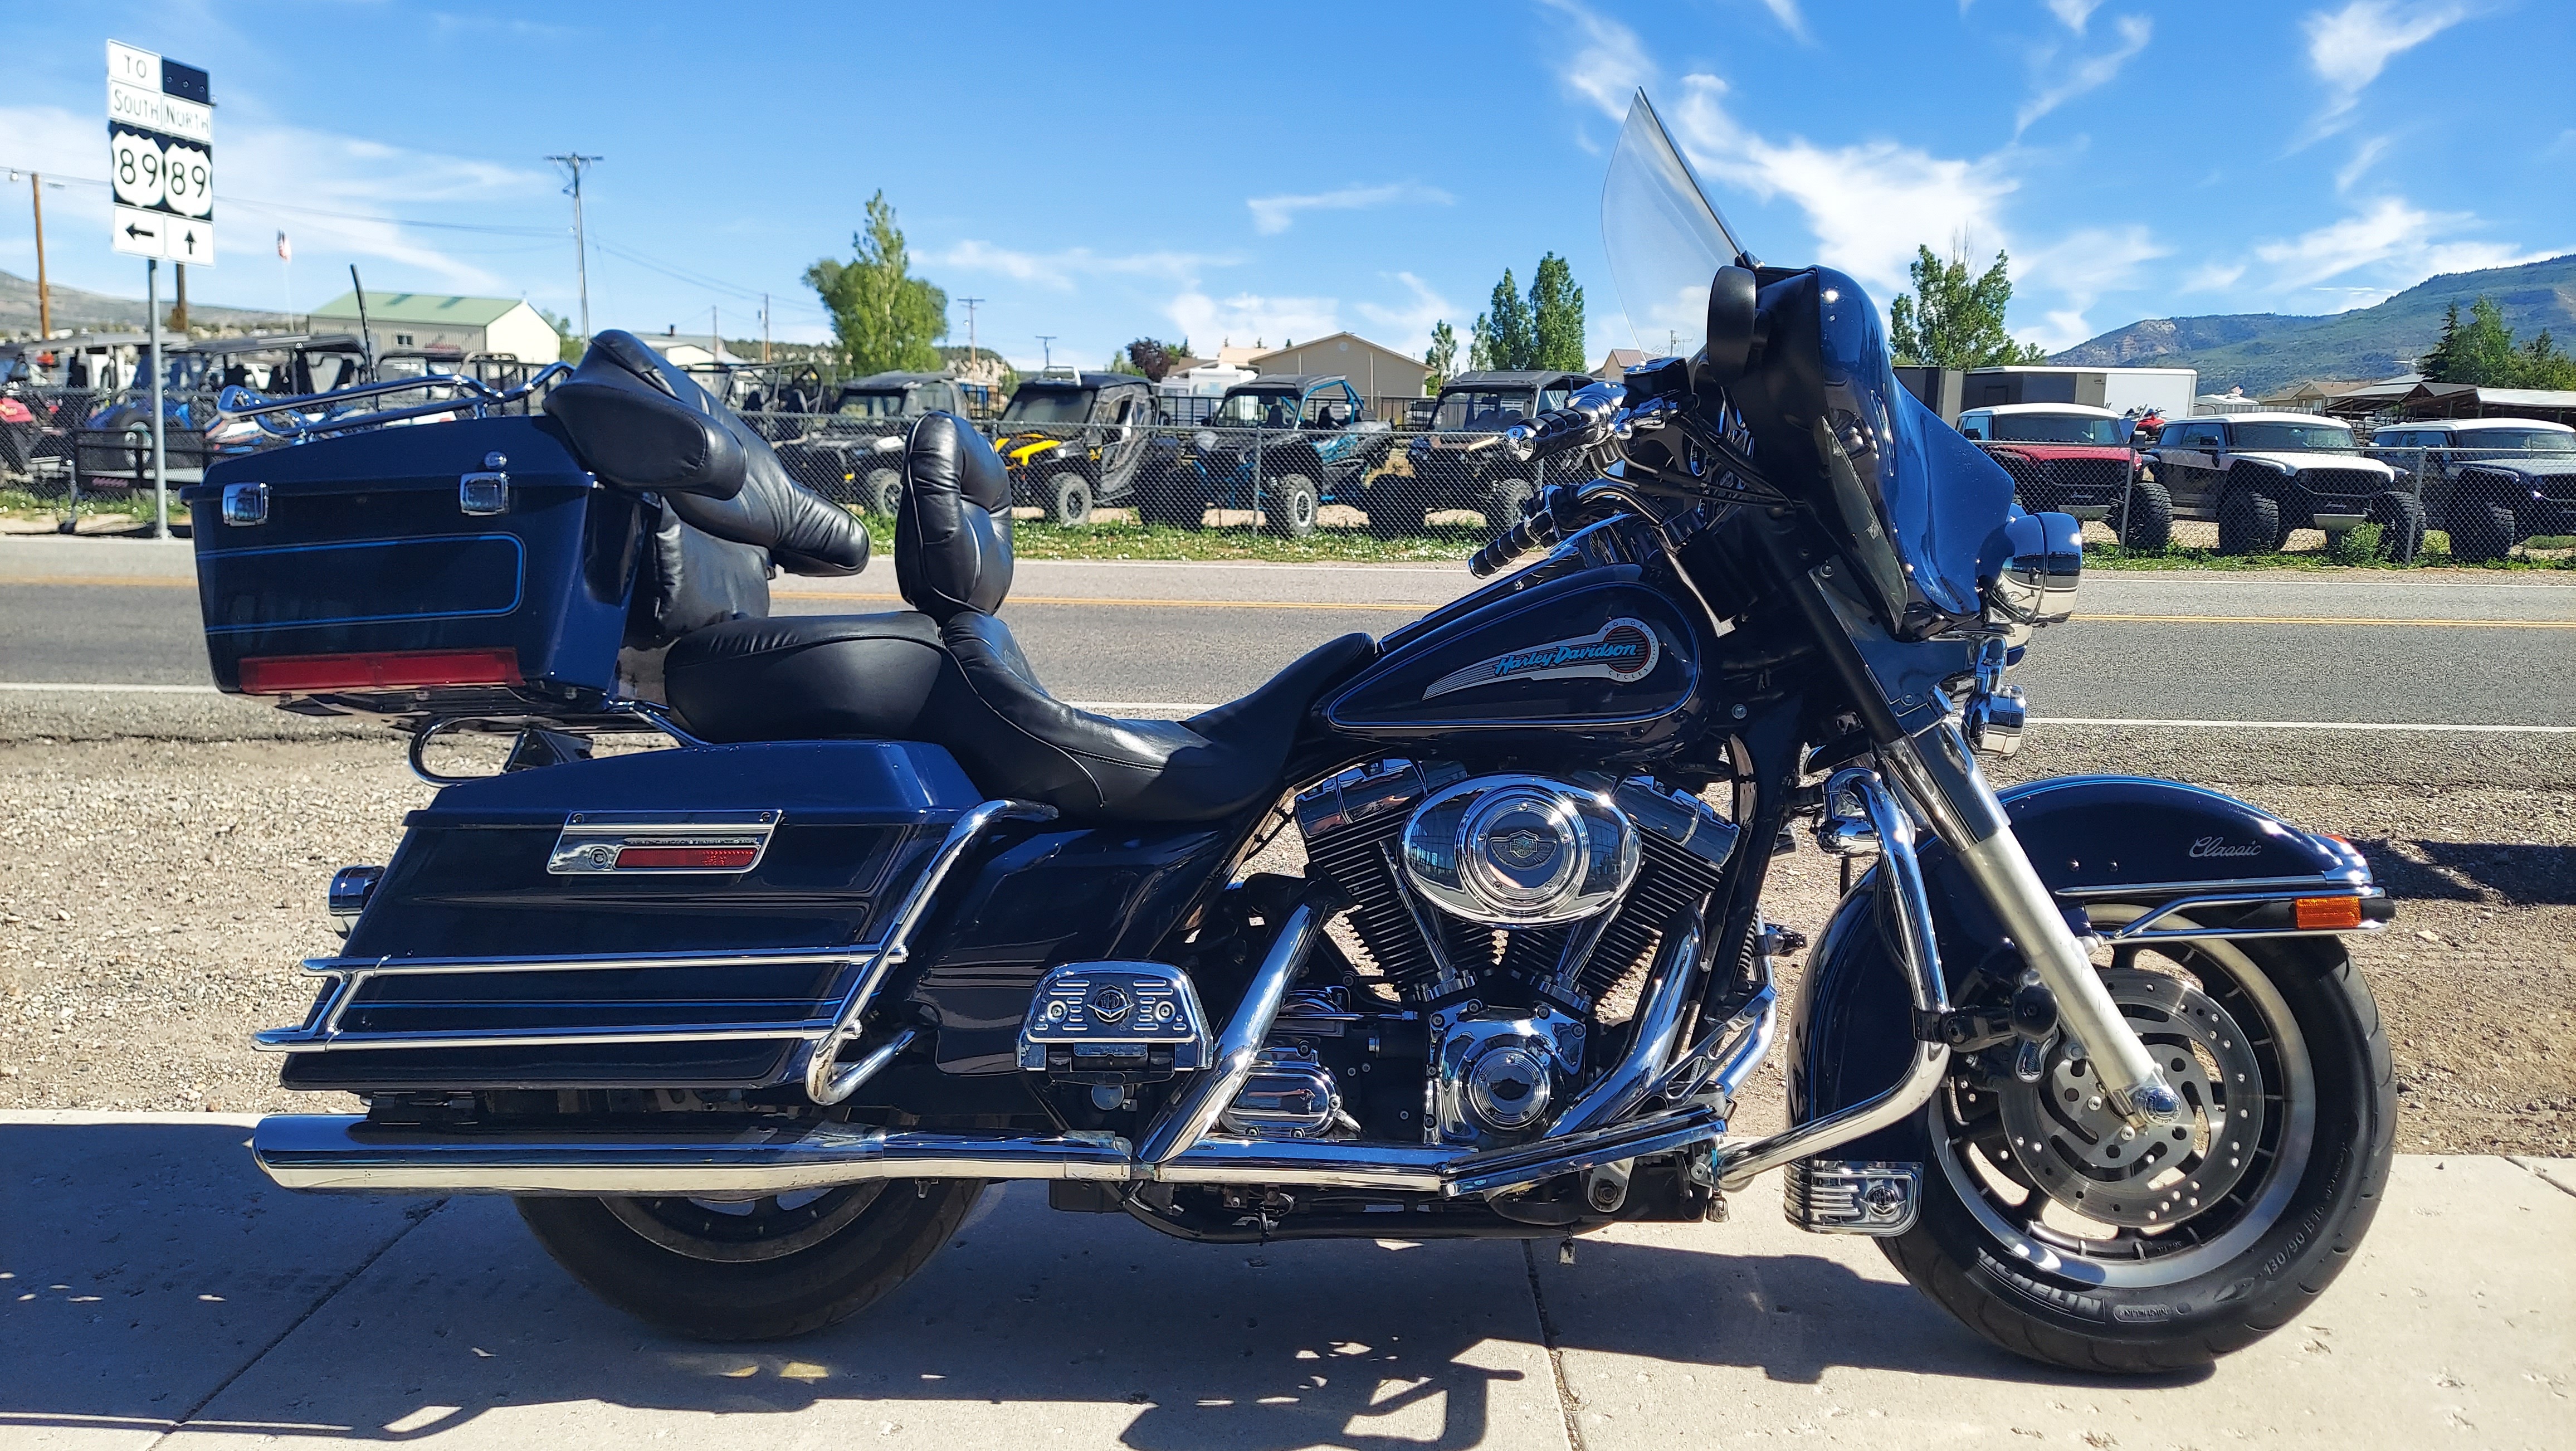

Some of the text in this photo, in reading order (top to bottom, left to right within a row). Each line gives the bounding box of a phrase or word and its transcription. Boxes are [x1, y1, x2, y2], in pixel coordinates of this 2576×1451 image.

[124, 54, 147, 79] TO
[114, 89, 159, 121] SOUTH
[166, 105, 209, 134] NORTH
[120, 148, 158, 188] 89
[170, 161, 206, 199] 89
[1604, 620, 1643, 632] MOTOR
[1495, 642, 1637, 675] Harley-Davidson
[1608, 668, 1648, 679] CYCLES
[2189, 836, 2262, 858] Classic
[2263, 1231, 2305, 1275] 130/90
